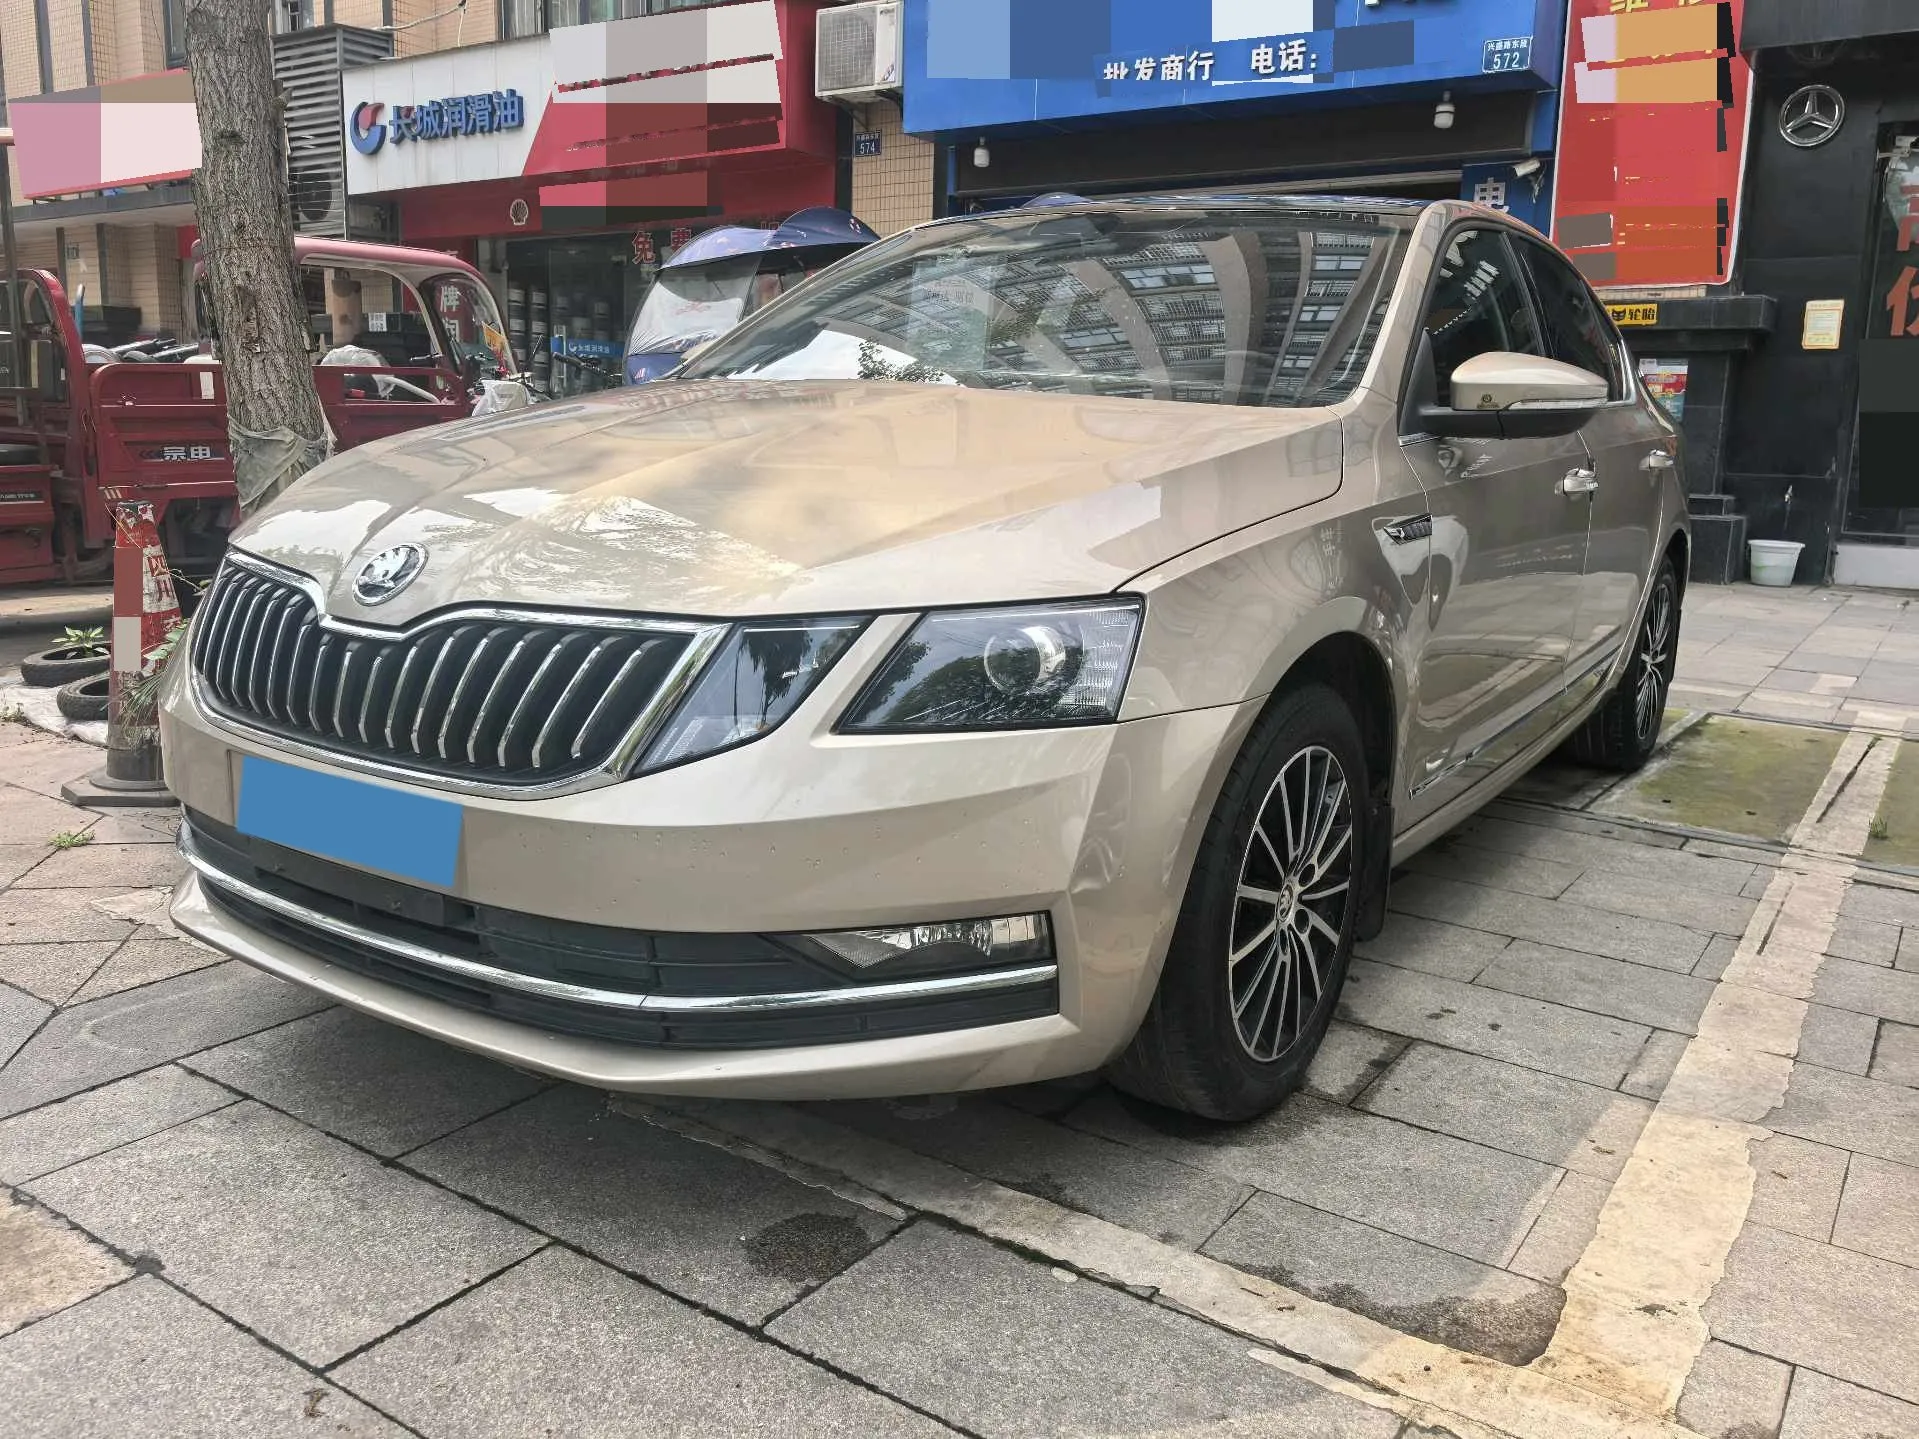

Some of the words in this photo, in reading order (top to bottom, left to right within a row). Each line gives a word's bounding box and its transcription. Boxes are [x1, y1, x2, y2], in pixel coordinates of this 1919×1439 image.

[1103, 50, 1215, 81] 批发商行
[1493, 51, 1520, 69] 572
[389, 88, 525, 146] 长城润滑油
[859, 140, 876, 155] 574
[1627, 307, 1657, 321] 轮胎
